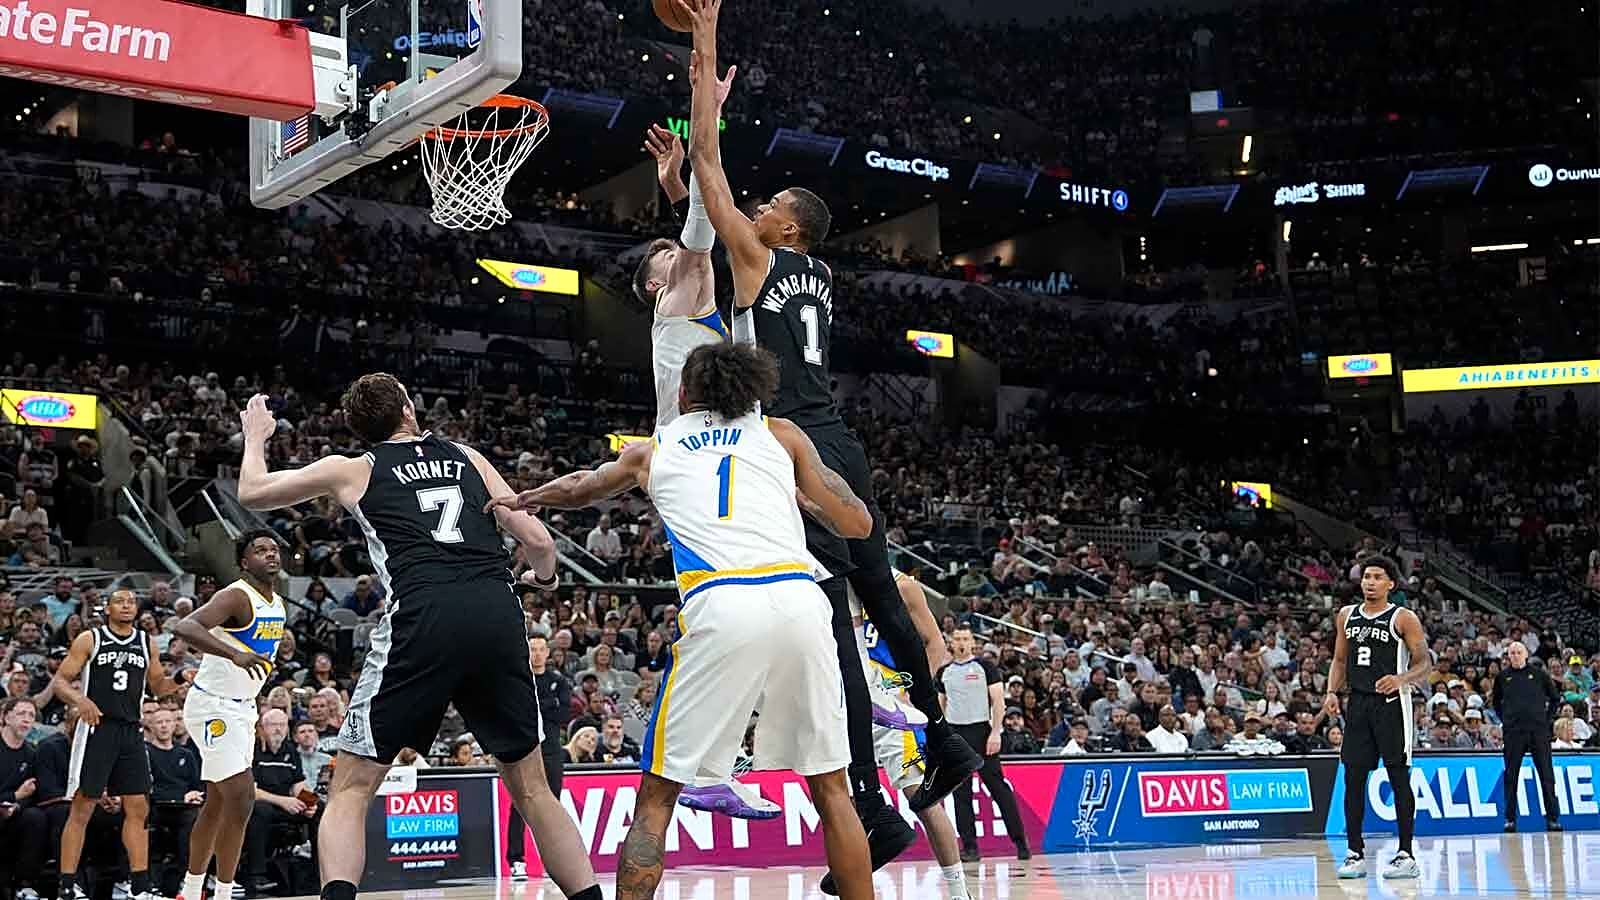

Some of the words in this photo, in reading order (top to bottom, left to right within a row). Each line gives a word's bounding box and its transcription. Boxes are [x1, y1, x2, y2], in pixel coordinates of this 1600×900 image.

[60, 7, 171, 61] Farm
[865, 150, 911, 173] Great
[911, 158, 949, 181] Clips
[761, 273, 833, 326] WEMBANYA
[800, 304, 823, 366] 1
[1459, 366, 1590, 384] AHIABENEFITS
[678, 428, 742, 451] TOPPIN
[391, 460, 466, 485] KORNET
[716, 454, 735, 520] 1
[415, 484, 465, 544] 7
[1357, 646, 1371, 667] 2
[112, 670, 129, 691] 3
[1146, 778, 1226, 808] DAVIS
[1232, 784, 1263, 800] LAW
[1268, 780, 1304, 798] FIRM
[1368, 766, 1498, 822] CALL
[390, 794, 455, 815] DAVIS
[391, 820, 420, 834] LAW
[424, 818, 456, 833] FIRM
[1204, 820, 1222, 831] SAN
[1222, 819, 1260, 831] ANTONIO
